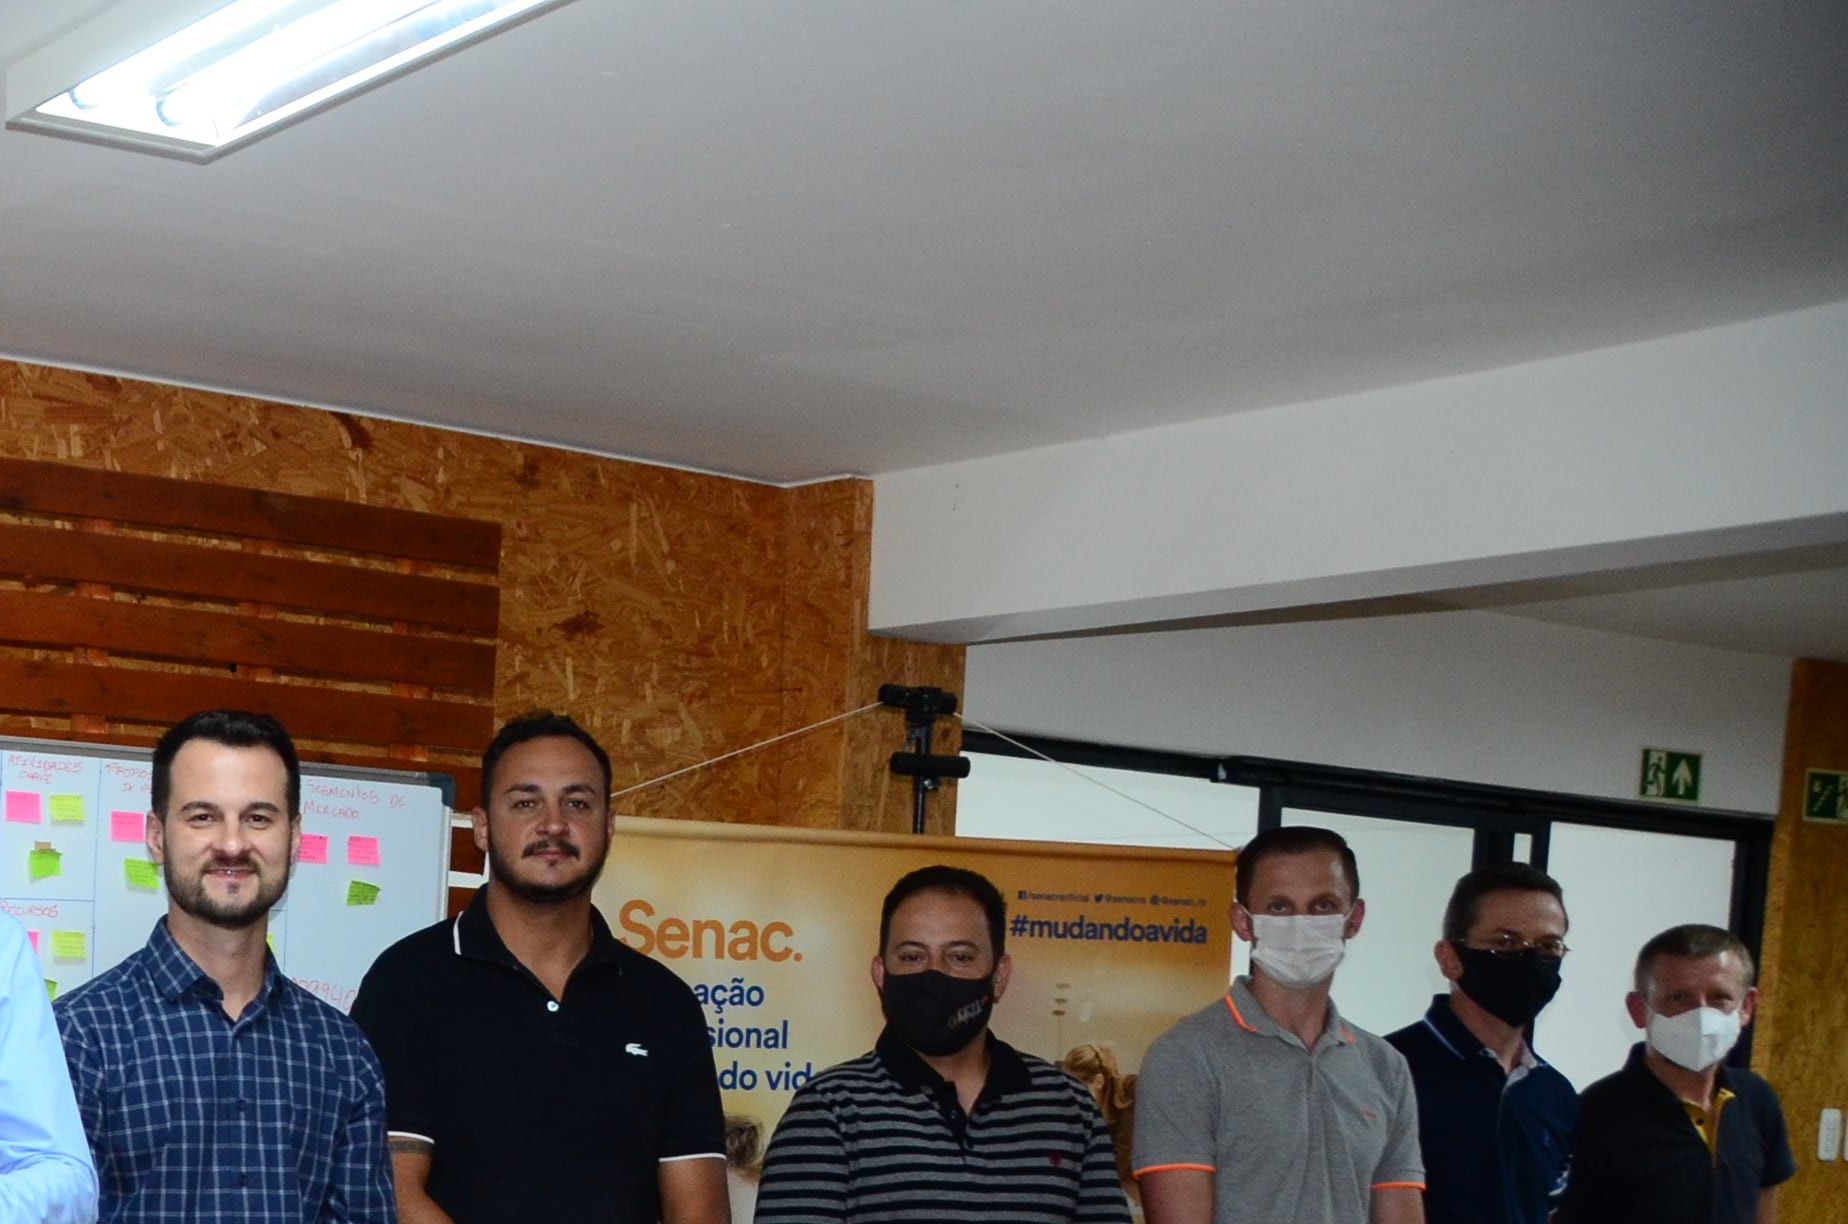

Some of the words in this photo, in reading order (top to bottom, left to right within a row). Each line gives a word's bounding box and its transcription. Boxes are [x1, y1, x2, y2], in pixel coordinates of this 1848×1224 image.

[1009, 913, 1208, 945] #mudandoavida
[693, 976, 766, 1014] ação
[707, 1017, 790, 1050] sional
[718, 1060, 759, 1091] do
[764, 1061, 814, 1092] vid
